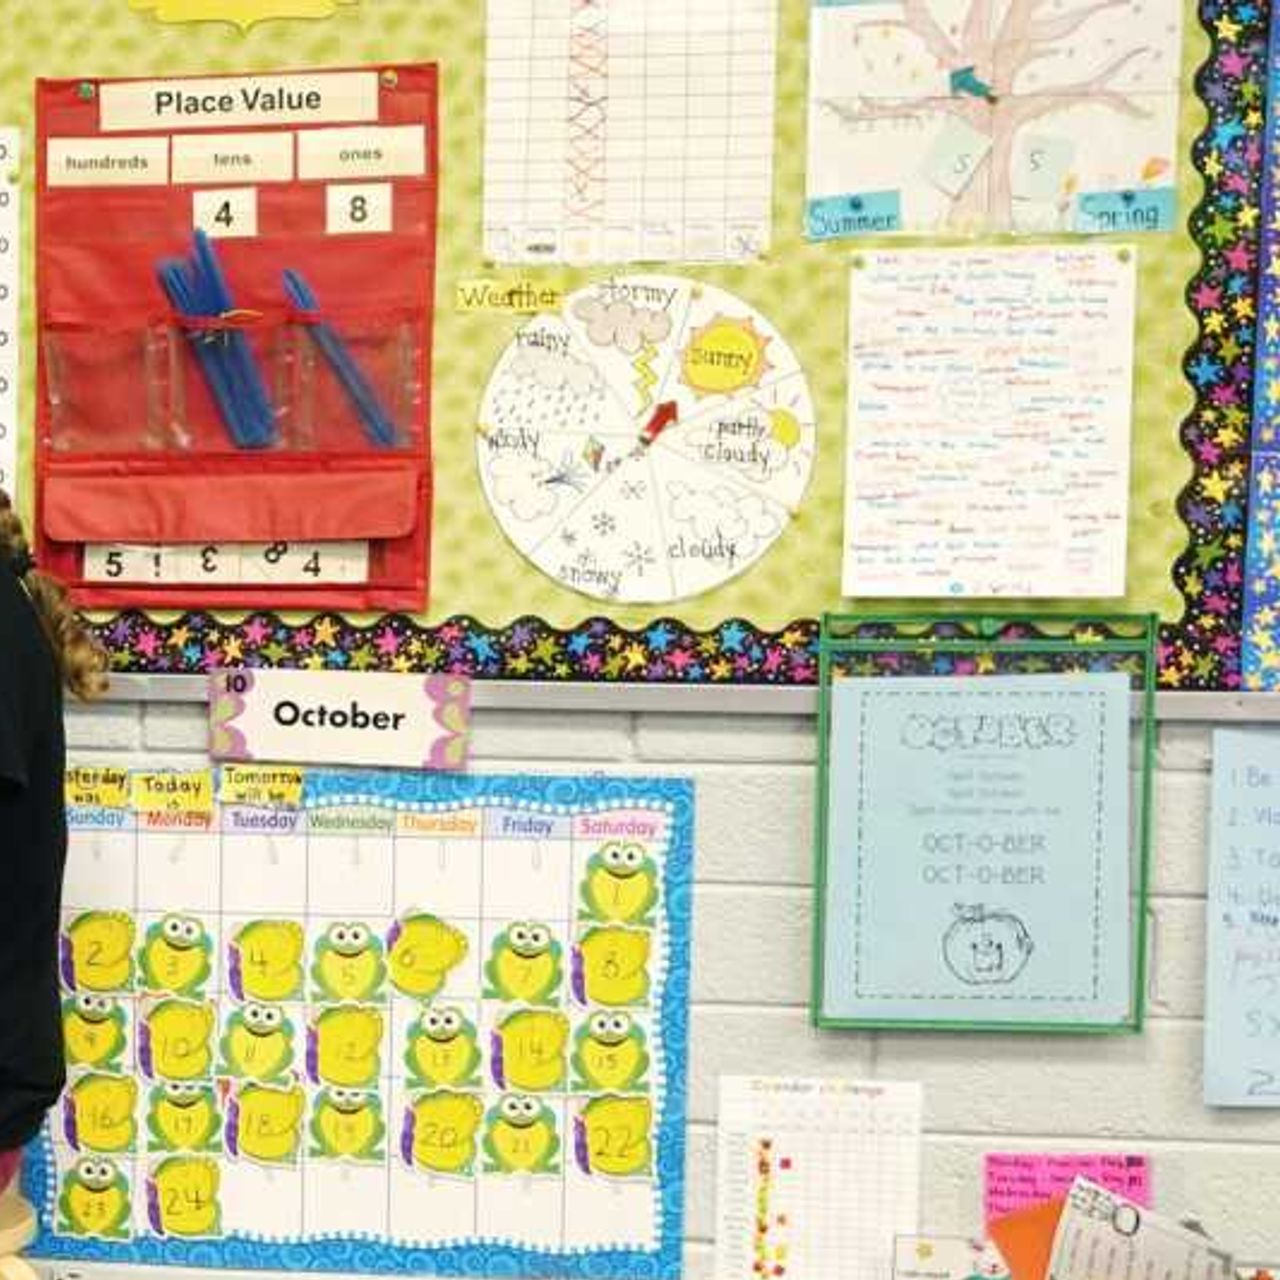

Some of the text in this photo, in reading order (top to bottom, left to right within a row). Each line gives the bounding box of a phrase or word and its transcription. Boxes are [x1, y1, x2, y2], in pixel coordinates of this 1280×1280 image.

[155, 88, 321, 115] Place Value
[65, 147, 383, 170] hundreds tens ones
[214, 196, 367, 227] 4 8
[811, 202, 896, 235] Summer
[704, 442, 770, 474] cloudy
[106, 552, 123, 577] 5
[303, 551, 320, 577] 4
[669, 534, 736, 568] cloudy
[226, 676, 246, 692] 10
[274, 701, 406, 730] October
[145, 778, 201, 794] Today
[67, 810, 656, 836] Sunday Monday Tuesday Wednesday Thursday Friday Saturday
[923, 833, 1045, 853] OCT-O-BER
[923, 865, 1045, 884] OCT-O-BER
[86, 941, 103, 965] 2
[249, 948, 267, 978] 4
[402, 949, 415, 966] 6
[162, 1038, 190, 1057] 10
[517, 1039, 543, 1059] 14
[594, 1054, 618, 1070] 15
[422, 1122, 458, 1148] 20
[596, 1128, 632, 1158] 22
[166, 1188, 205, 1216] 24
